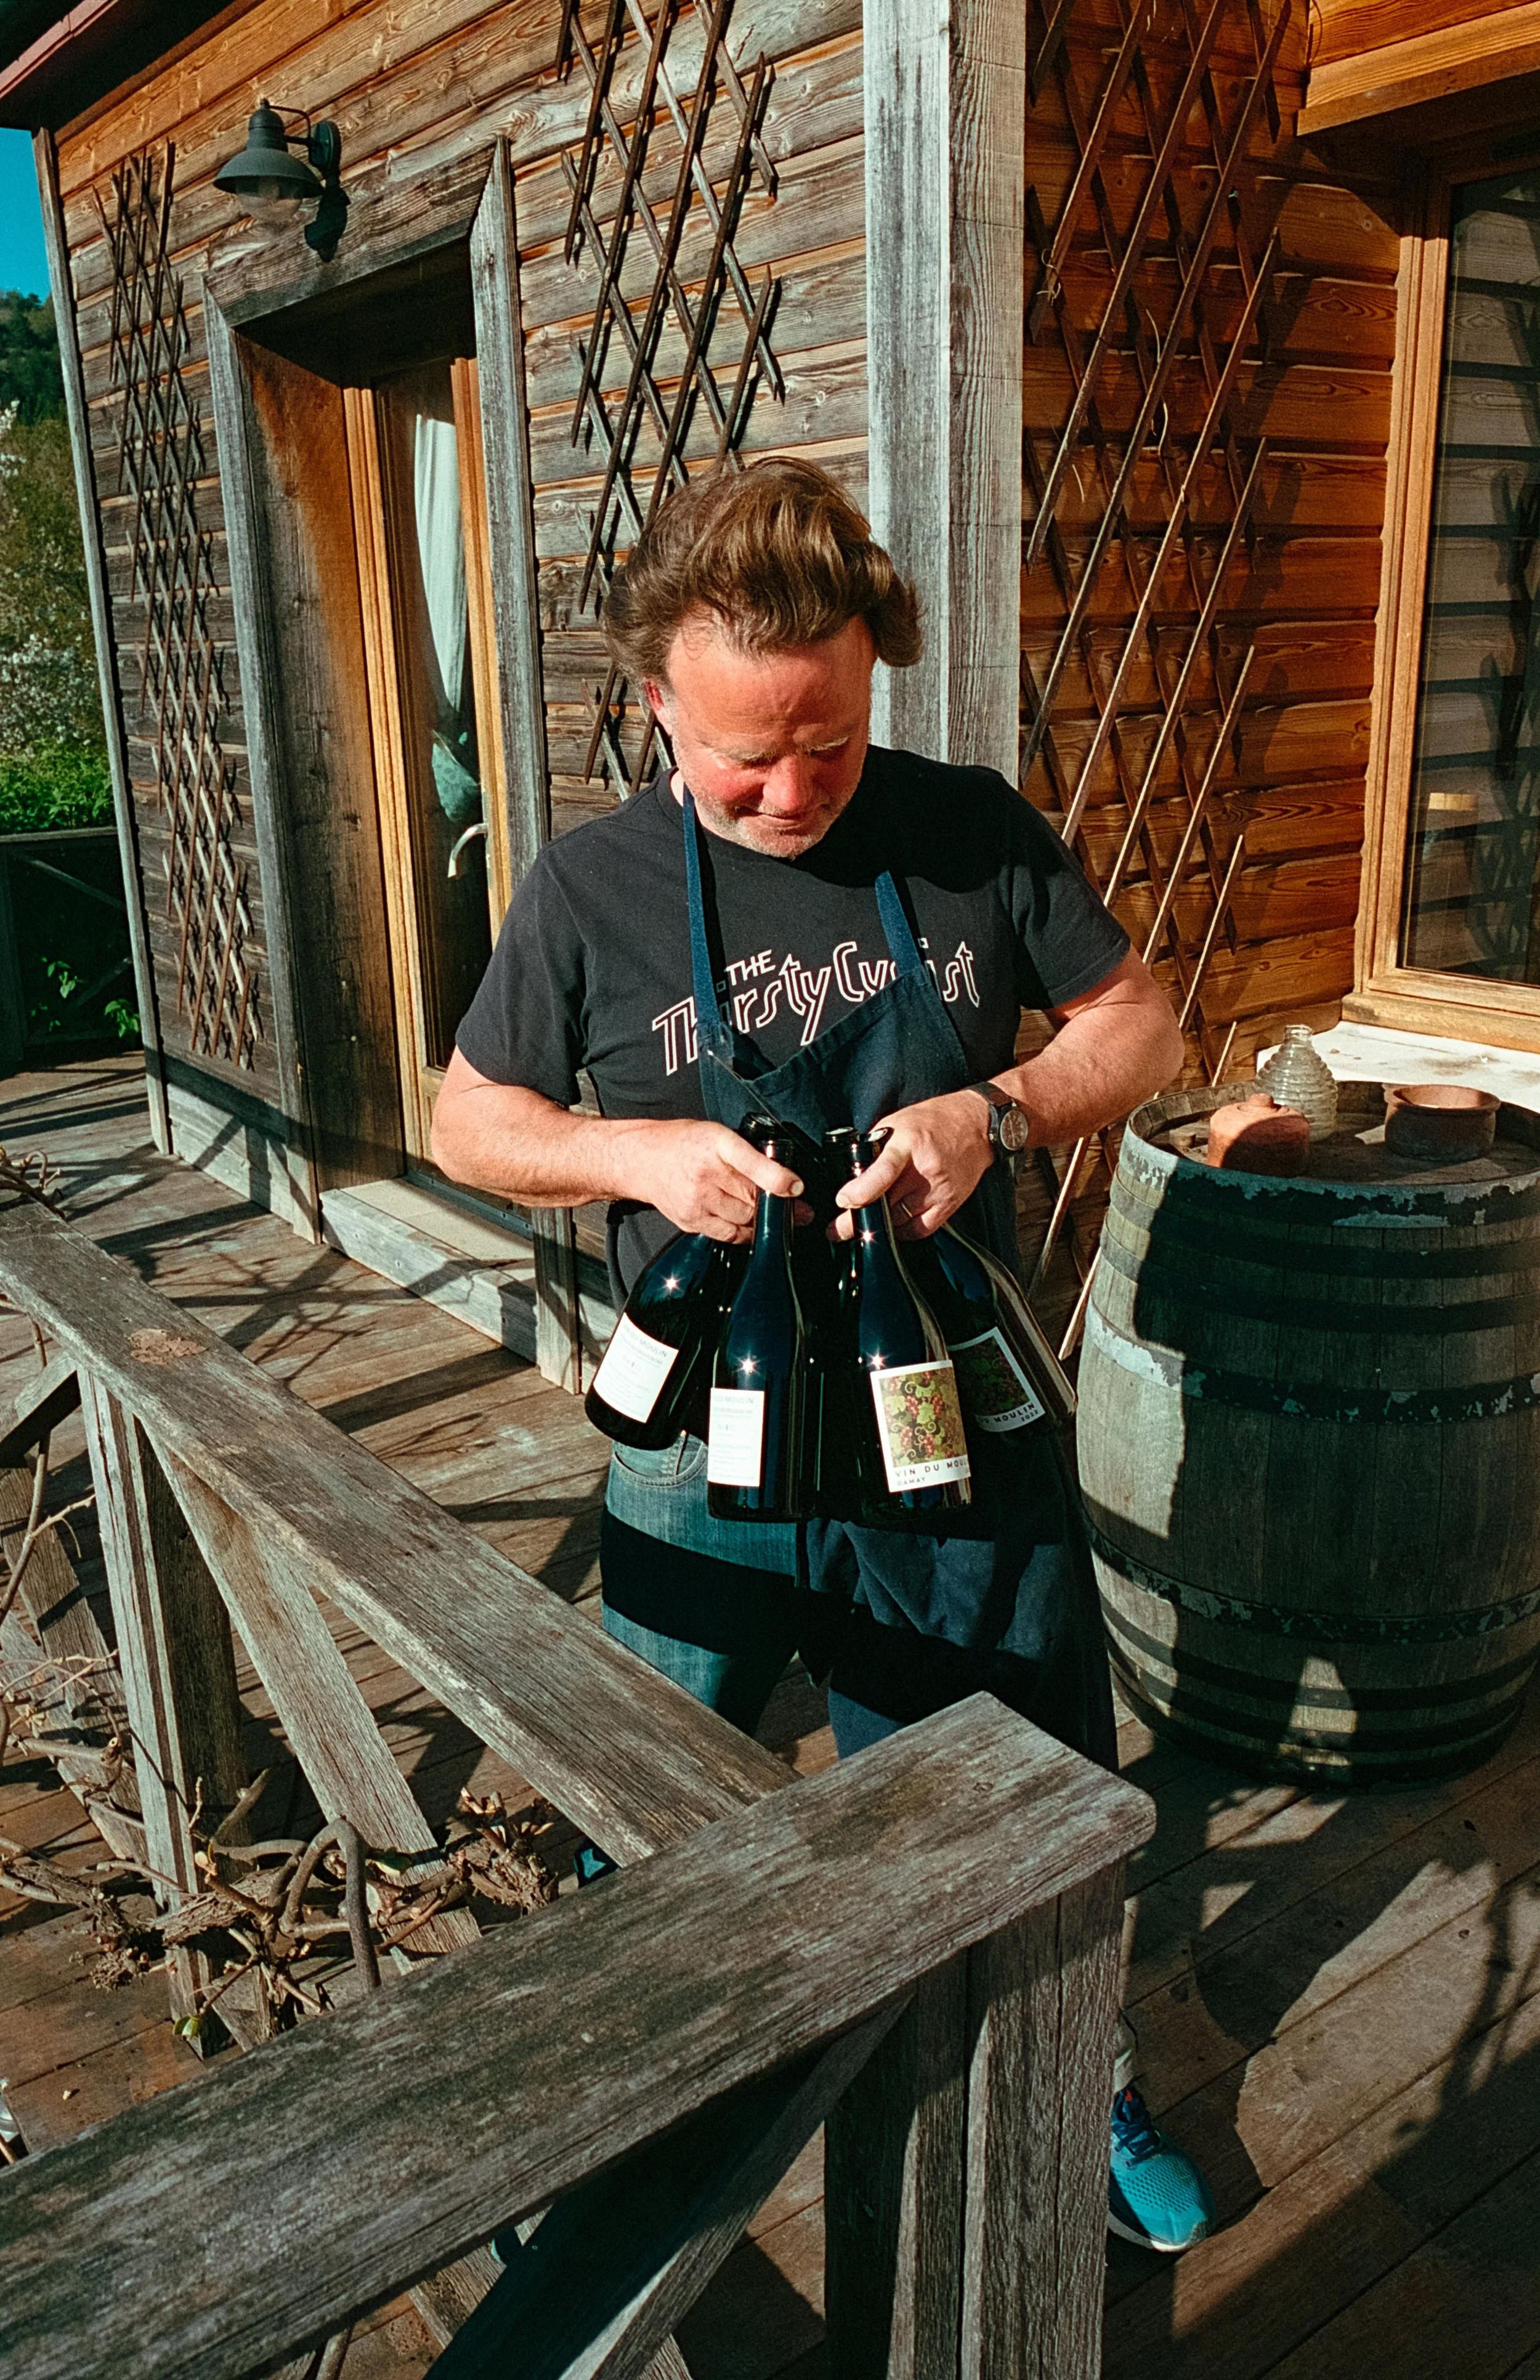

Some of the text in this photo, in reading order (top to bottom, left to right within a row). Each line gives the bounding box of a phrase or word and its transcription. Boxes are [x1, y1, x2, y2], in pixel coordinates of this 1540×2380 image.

[725, 949, 776, 986] THE
[639, 1338, 668, 1358] MOULIN
[725, 1395, 755, 1404] MOULIN
[993, 1402, 1035, 1423] MOULIN
[1021, 1409, 1039, 1422] 2022
[895, 1468, 916, 1477] VIN
[924, 1465, 940, 1473] DU
[897, 1477, 926, 1486] GAMAY
